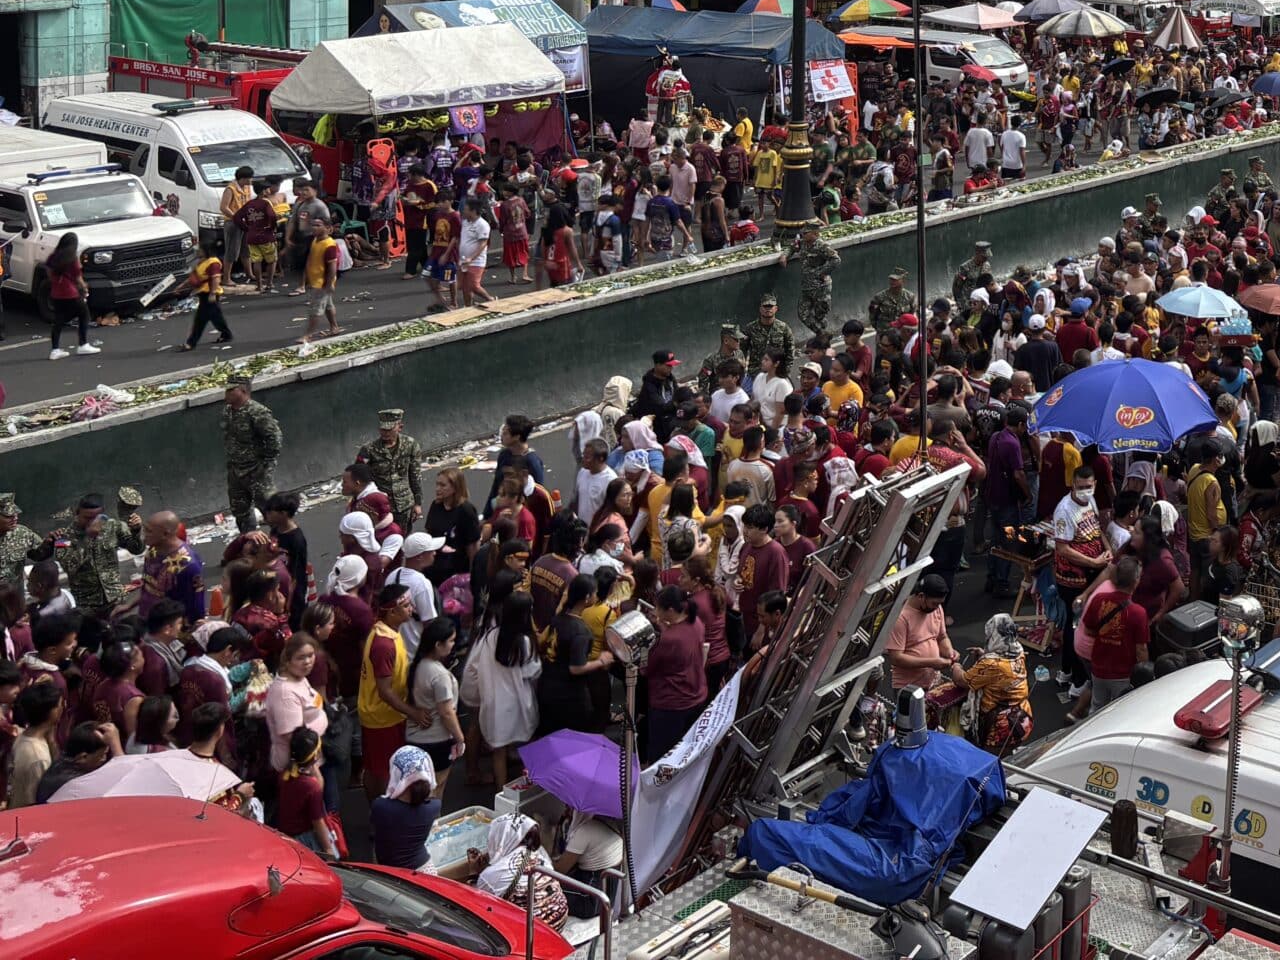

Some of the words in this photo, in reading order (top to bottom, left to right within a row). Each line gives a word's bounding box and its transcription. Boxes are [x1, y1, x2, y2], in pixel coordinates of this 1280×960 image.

[162, 65, 182, 76] SAN
[185, 70, 208, 81] JOSE
[61, 113, 75, 124] SAN
[75, 115, 93, 127] JOSE
[93, 118, 121, 132] HEALTH
[121, 124, 150, 138] CENTER
[1112, 438, 1159, 449] Negosyo
[1087, 760, 1119, 790] 2D
[1085, 783, 1116, 800] LOTTO
[1136, 776, 1170, 806] 3D
[1233, 808, 1267, 839] 6D
